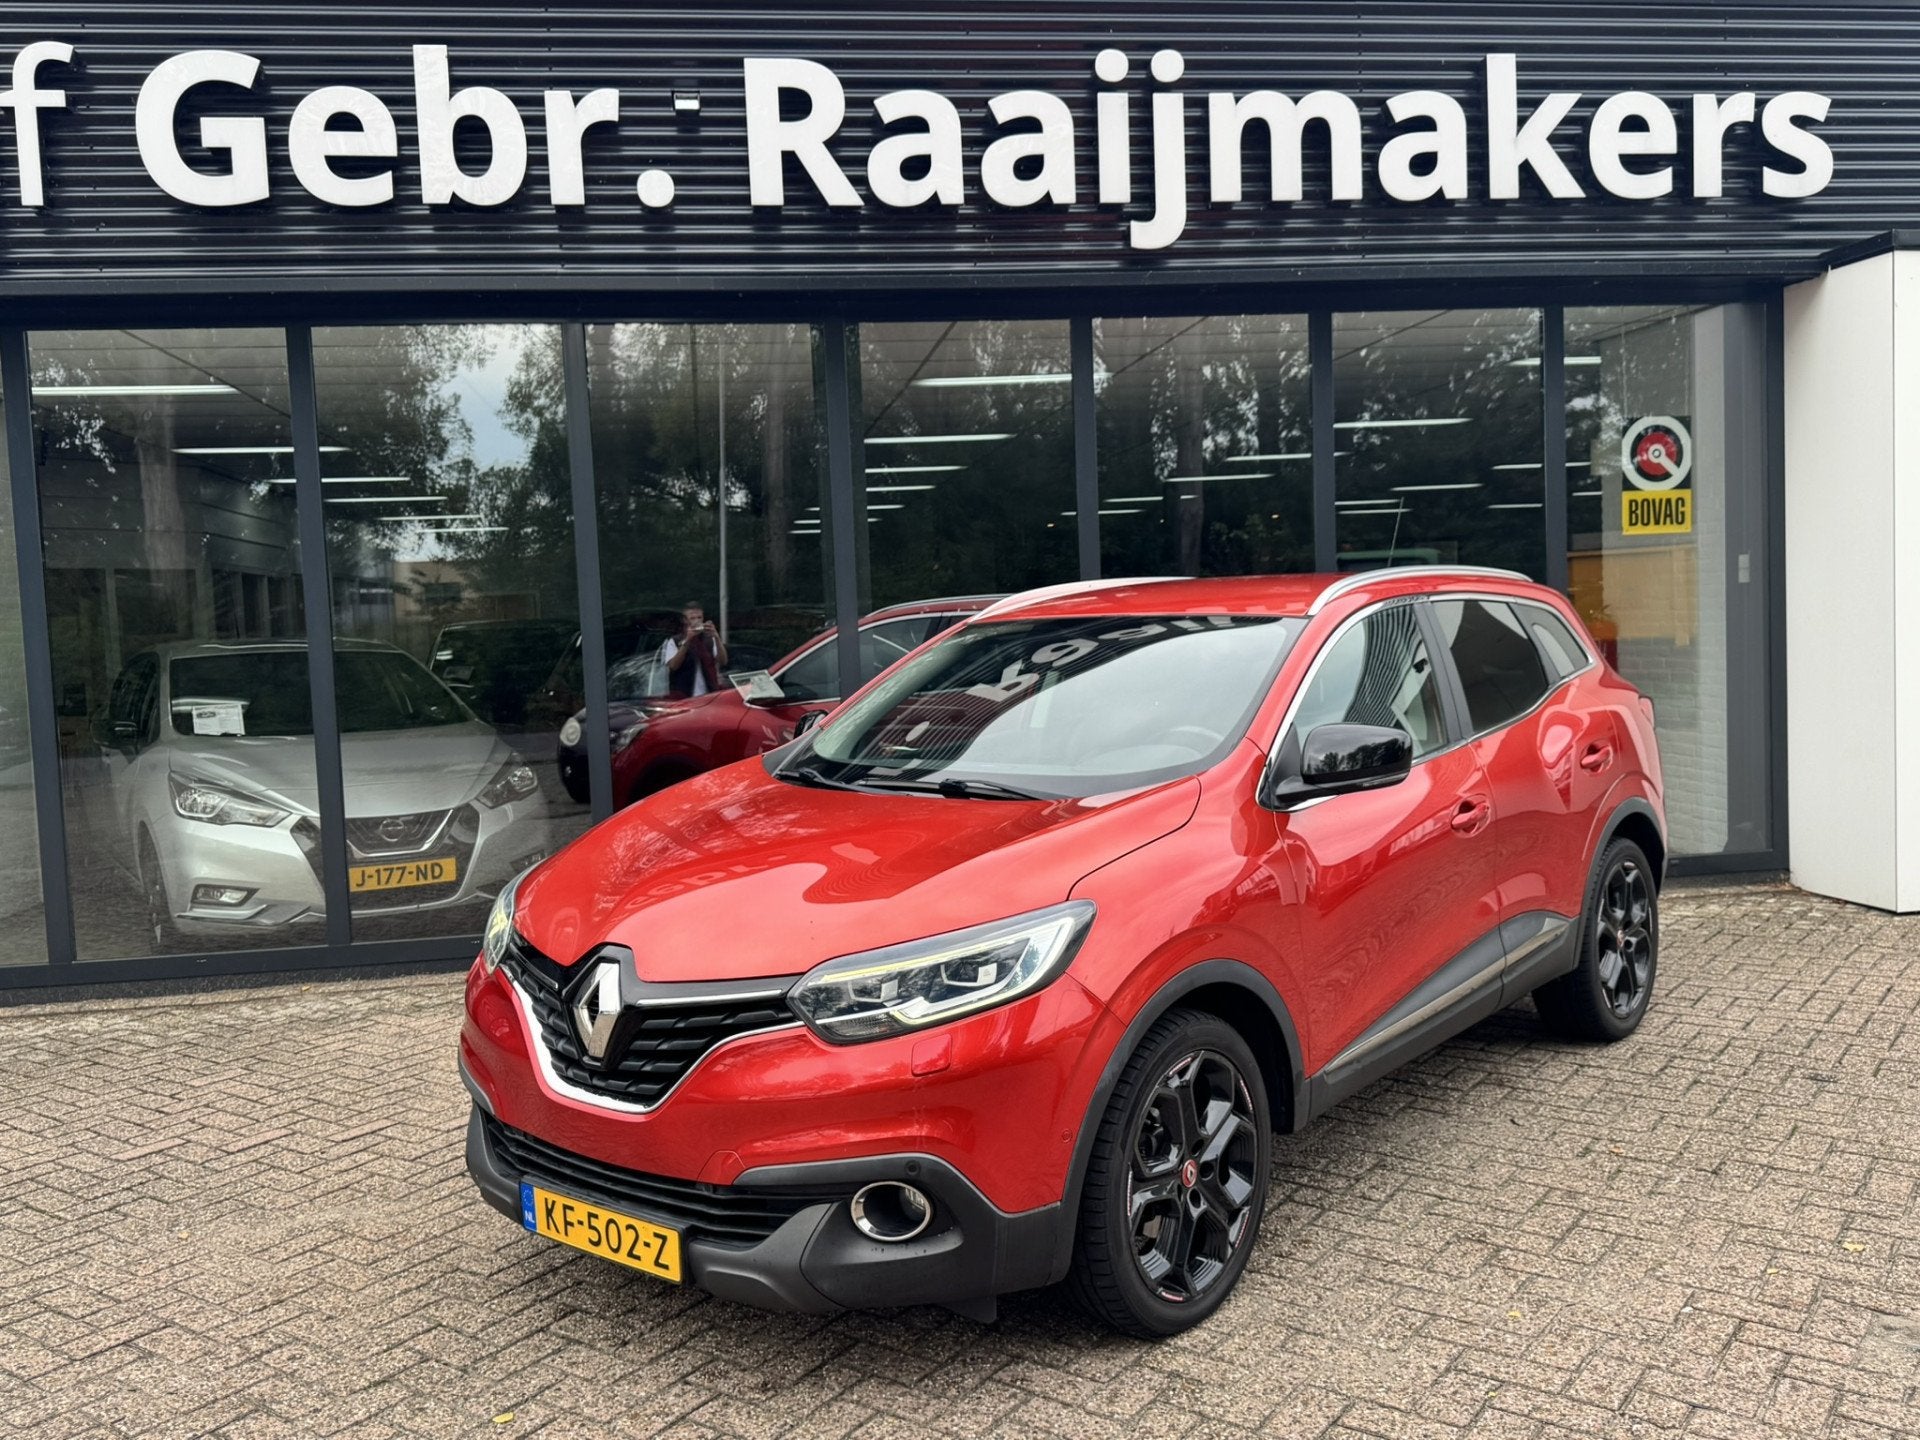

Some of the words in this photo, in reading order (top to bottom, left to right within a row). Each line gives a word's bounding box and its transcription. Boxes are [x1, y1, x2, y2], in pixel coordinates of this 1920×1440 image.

[135, 44, 676, 208] Gebr.
[743, 49, 1835, 250] Raaijmakers
[1628, 497, 1686, 527] BOVAG
[355, 862, 444, 888] J-177-ND
[524, 1209, 536, 1224] NL
[544, 1197, 670, 1271] KF-502-Z
